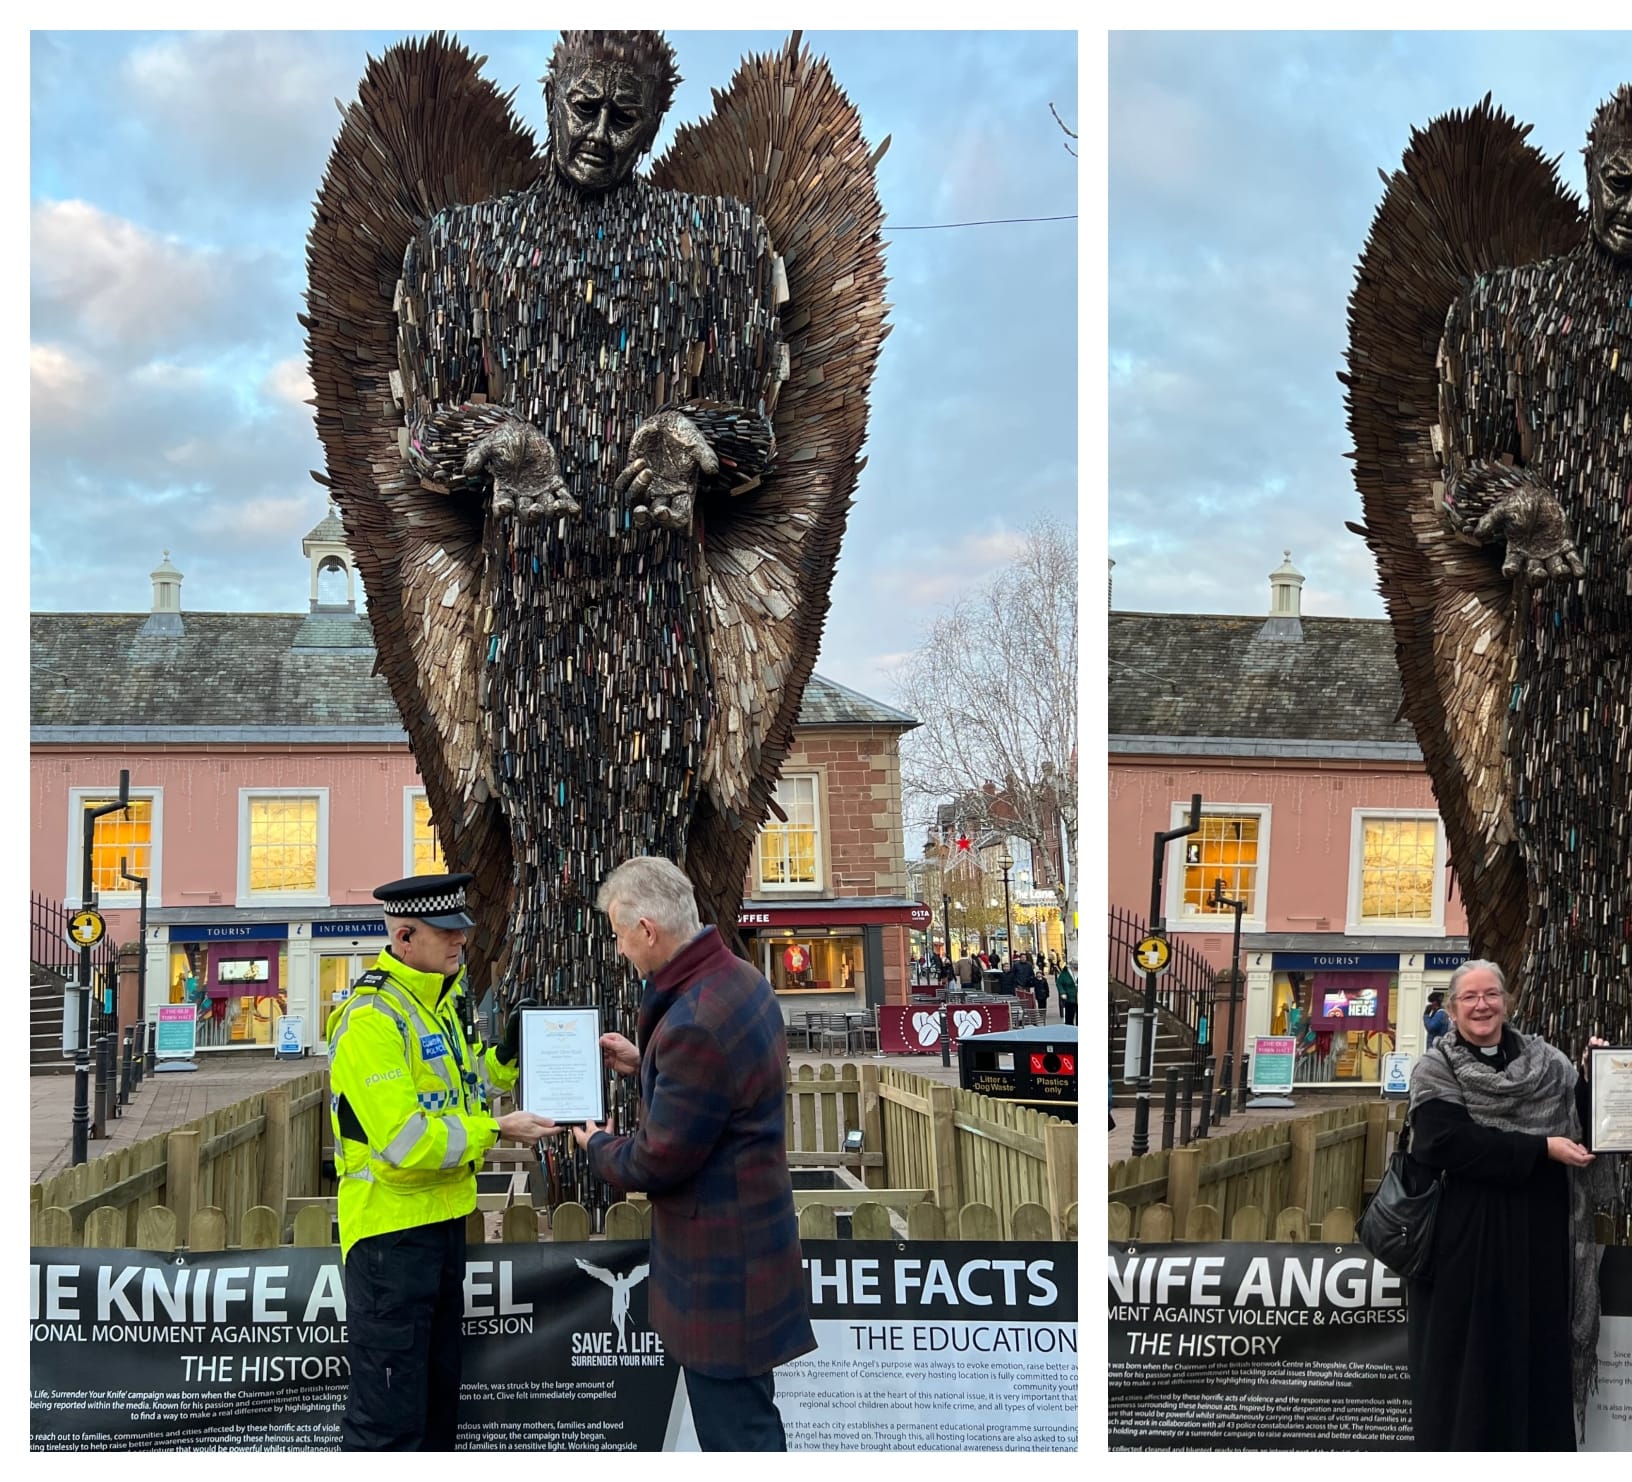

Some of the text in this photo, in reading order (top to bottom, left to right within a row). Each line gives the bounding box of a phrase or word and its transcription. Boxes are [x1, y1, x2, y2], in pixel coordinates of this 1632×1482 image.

[320, 924, 386, 932] INFORMATIO
[1348, 1005, 1375, 1016] HERE
[426, 1046, 444, 1055] POLIC
[365, 1068, 403, 1087] POLICE
[1036, 1078, 1068, 1086] Plastics
[975, 1083, 990, 1092] Dog
[894, 1259, 1058, 1306] FACTS
[1108, 1256, 1408, 1308] NIFE ANGE
[97, 1265, 289, 1322] KNIFE
[1153, 1308, 1225, 1323] AGAINST
[1228, 1309, 1308, 1325] VIOLENCE
[1313, 1311, 1325, 1325] &
[93, 1325, 205, 1343] MONUMENT
[210, 1326, 293, 1343] AGAINST
[297, 1326, 349, 1343] VIOLE
[461, 1317, 533, 1336] ESSION
[850, 1326, 1078, 1352] THE EDUCATION
[572, 1333, 664, 1353] SAVE A LIFE
[1127, 1332, 1281, 1357] THE HISTORY
[180, 1356, 233, 1382] THE
[572, 1356, 664, 1367] SURRENDER YOUR KNIFE
[881, 1362, 912, 1370] purpose
[930, 1361, 955, 1370] always
[34, 1390, 49, 1399] Life,
[51, 1390, 88, 1398] Surrender
[128, 1391, 164, 1403] campaign
[182, 1391, 199, 1399] born
